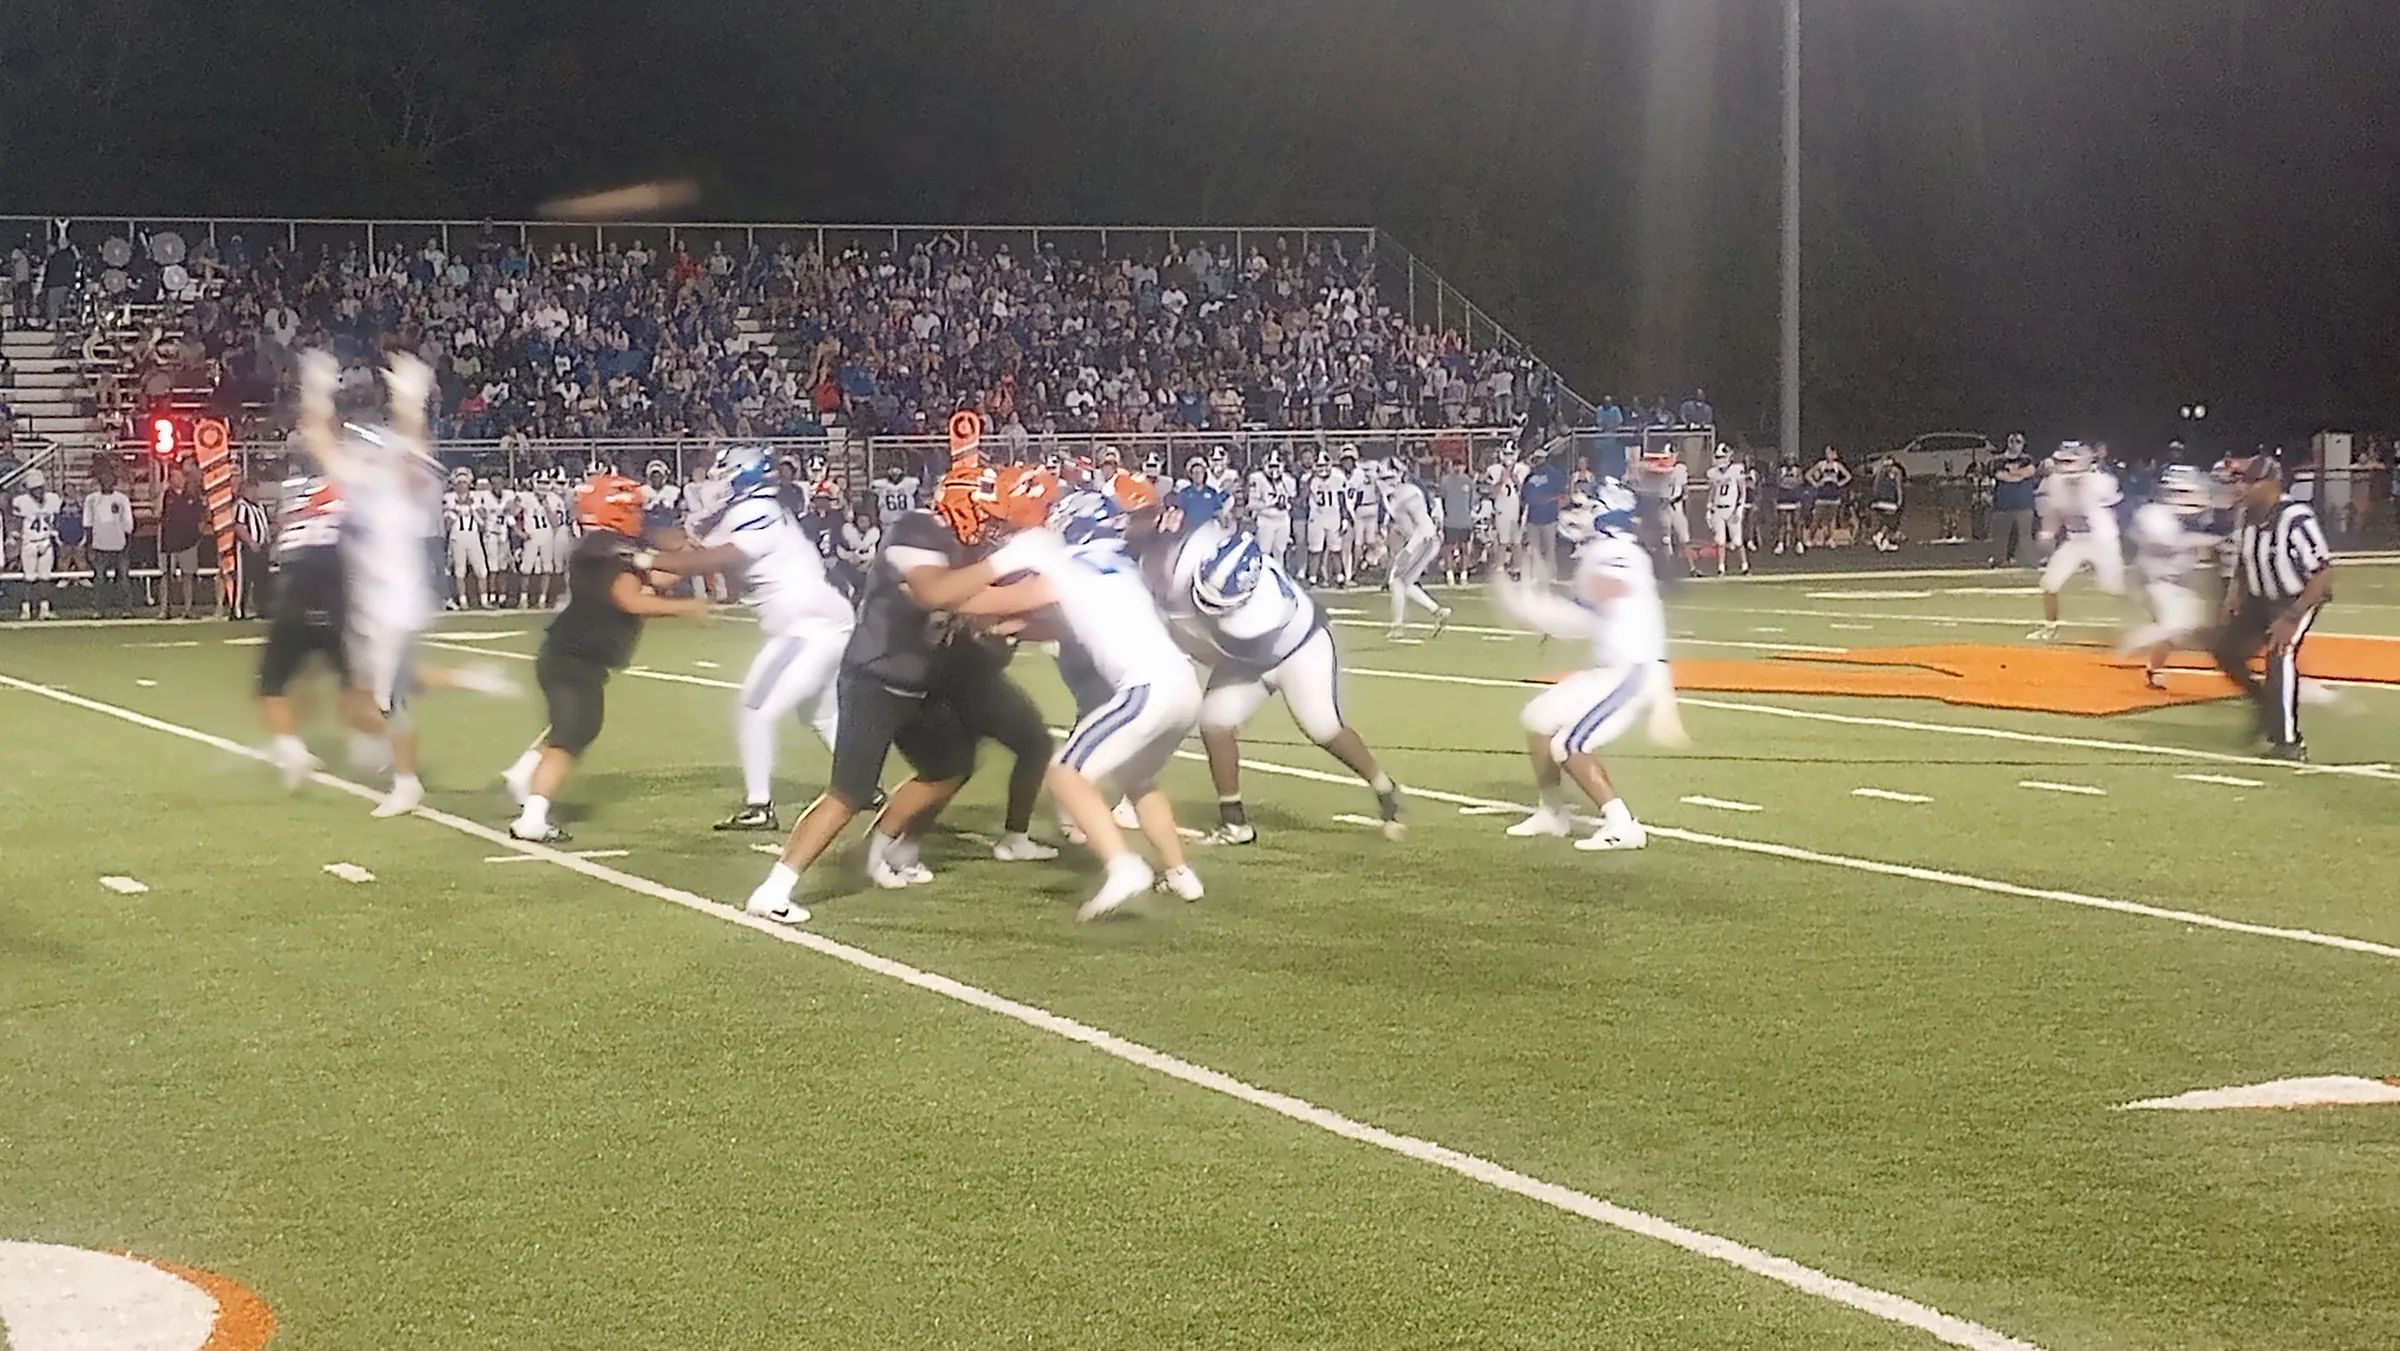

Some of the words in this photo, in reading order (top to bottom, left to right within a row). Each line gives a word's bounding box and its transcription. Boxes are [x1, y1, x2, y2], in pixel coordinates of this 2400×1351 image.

[155, 419, 174, 453] 3
[887, 494, 907, 511] 68
[1316, 490, 1332, 507] 31
